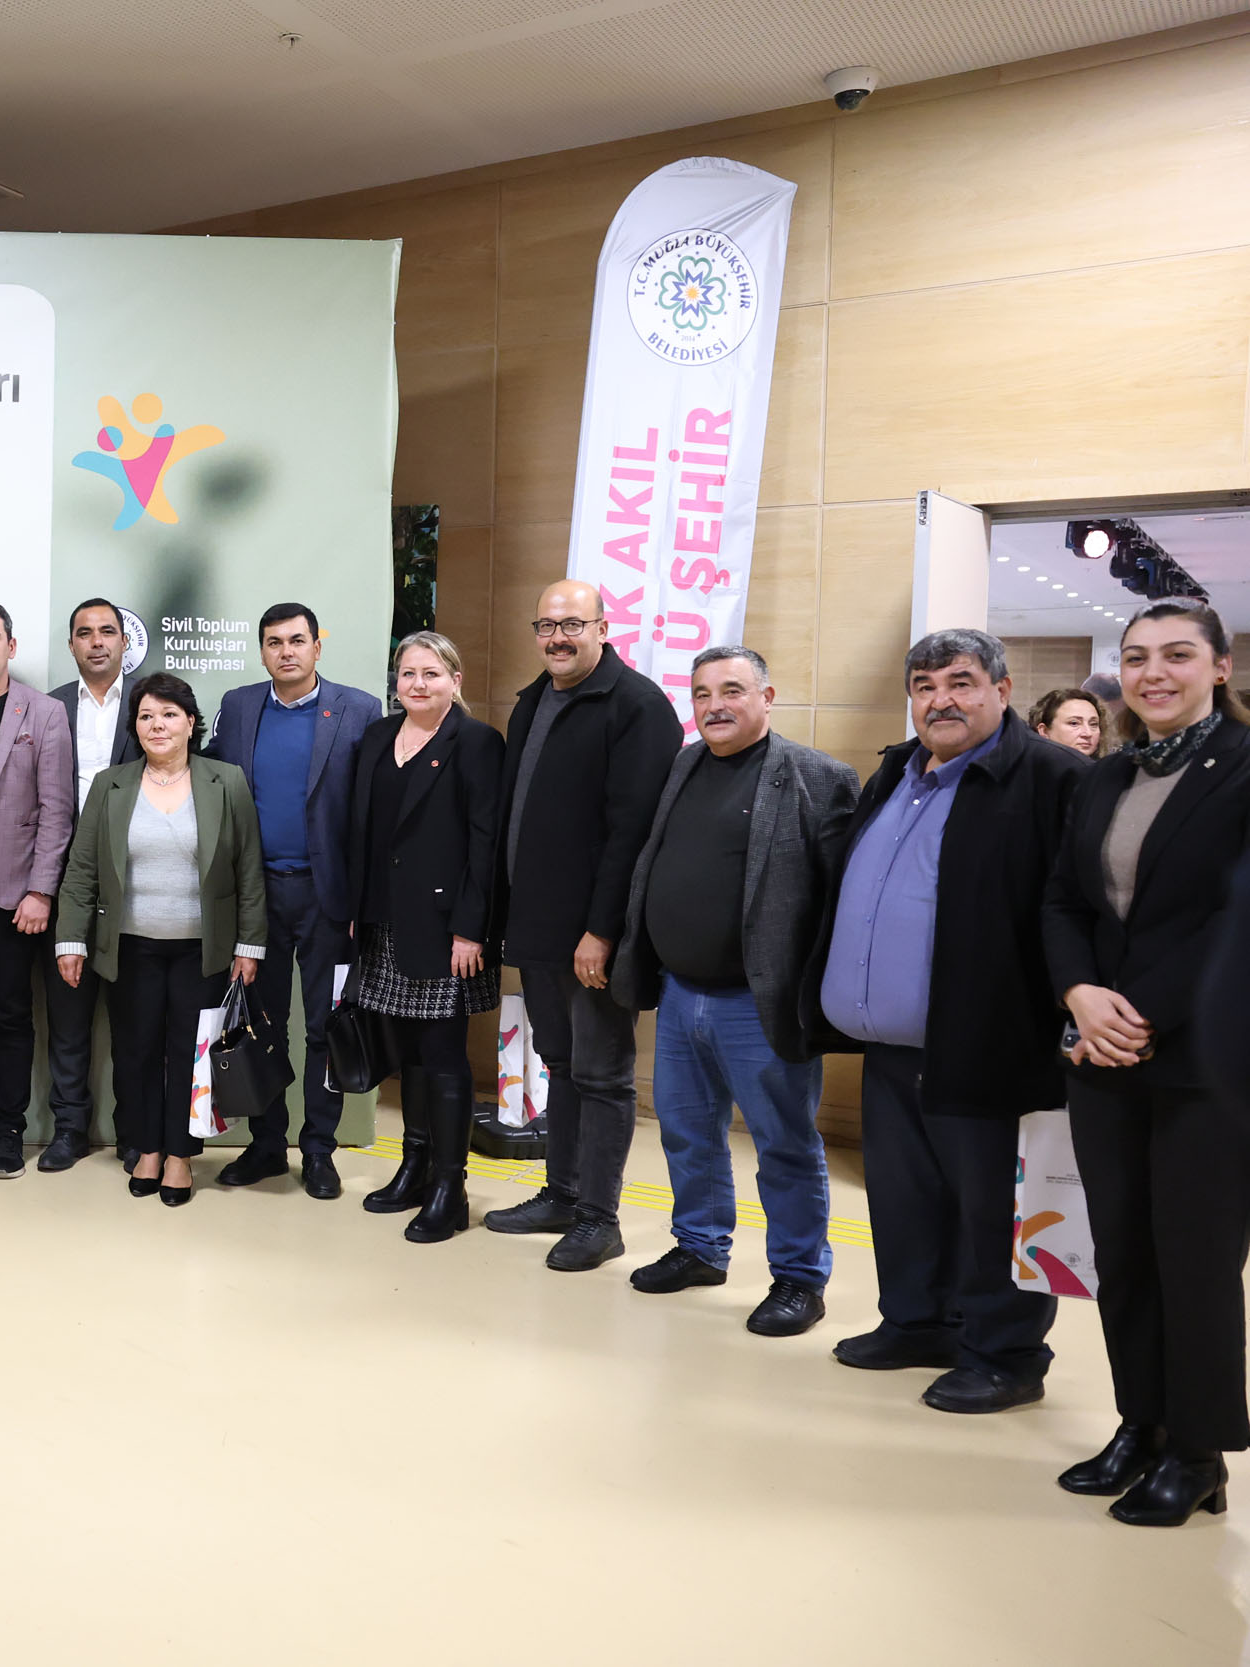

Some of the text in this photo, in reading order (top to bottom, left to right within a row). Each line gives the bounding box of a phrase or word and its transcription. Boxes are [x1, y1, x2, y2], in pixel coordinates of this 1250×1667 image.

[694, 234, 754, 309] BÜYÜKŞEHİR
[647, 331, 729, 361] BELEDİYESİ
[668, 406, 732, 595] ŞEHİR
[600, 427, 659, 670] AK AKIL
[161, 616, 250, 636] Sivil Toplum
[164, 636, 247, 655] Kuruluşları
[165, 655, 245, 674] Buluşması
